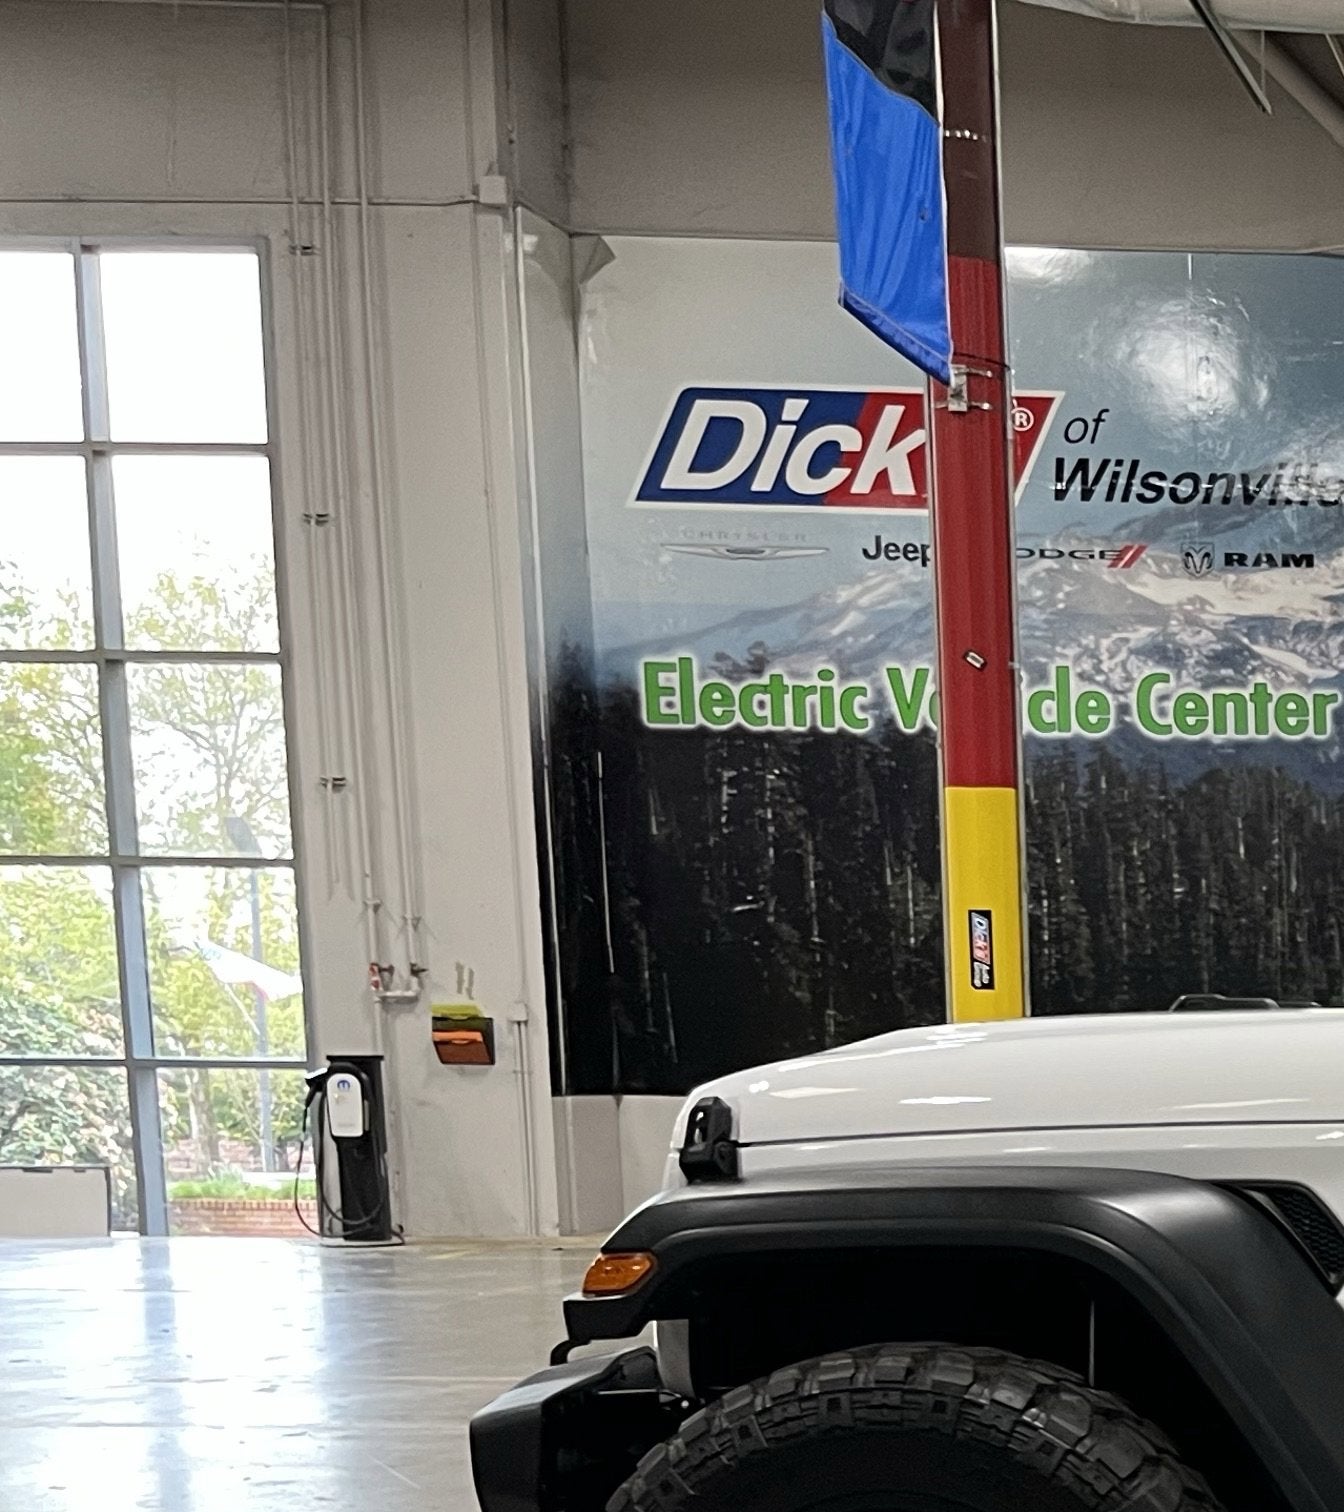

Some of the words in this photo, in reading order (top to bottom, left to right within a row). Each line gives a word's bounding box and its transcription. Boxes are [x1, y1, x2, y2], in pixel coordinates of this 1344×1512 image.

[1064, 408, 1110, 444] of
[660, 398, 930, 496] Dick
[1016, 547, 1121, 560] ODGE
[1224, 552, 1315, 568] RAM
[644, 657, 869, 729] Electric
[886, 666, 1111, 733] Vcle
[1137, 672, 1339, 736] Center
